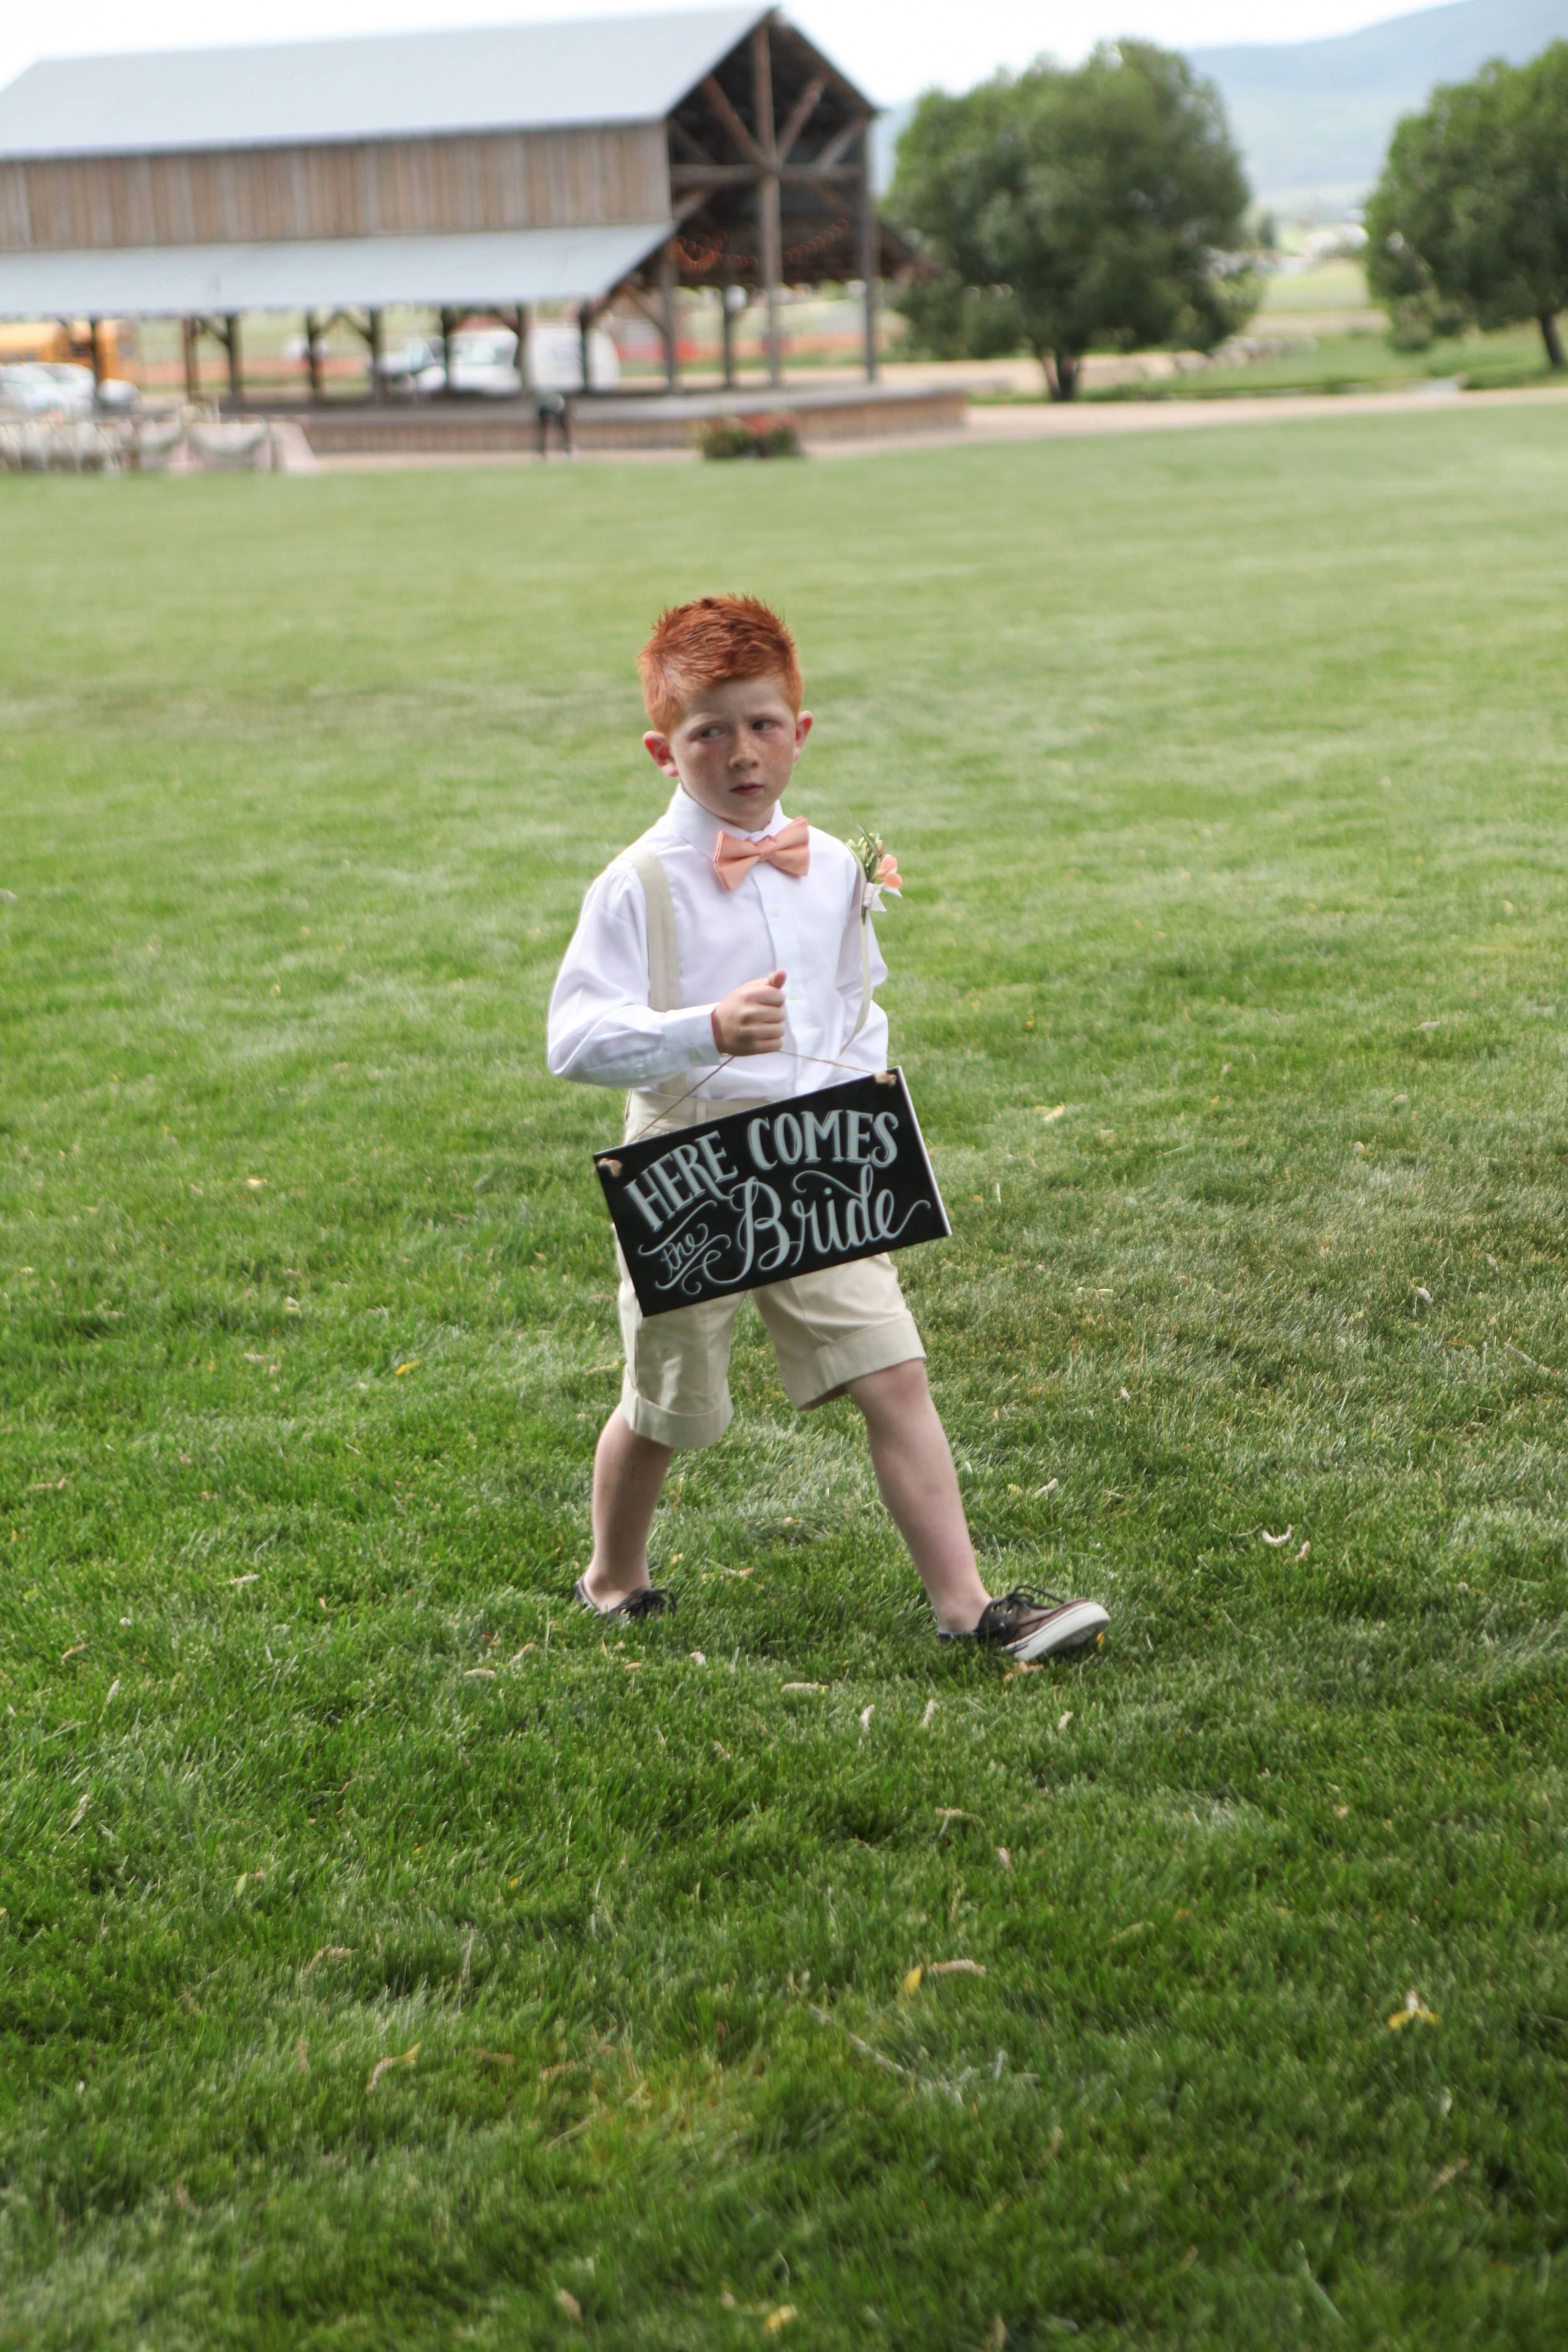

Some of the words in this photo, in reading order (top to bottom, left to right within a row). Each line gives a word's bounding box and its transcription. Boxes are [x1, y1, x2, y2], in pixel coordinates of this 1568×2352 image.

[625, 1131, 739, 1232] HERE
[748, 1110, 899, 1170] COMES
[661, 1222, 709, 1279] the
[702, 1164, 931, 1285] Bride
